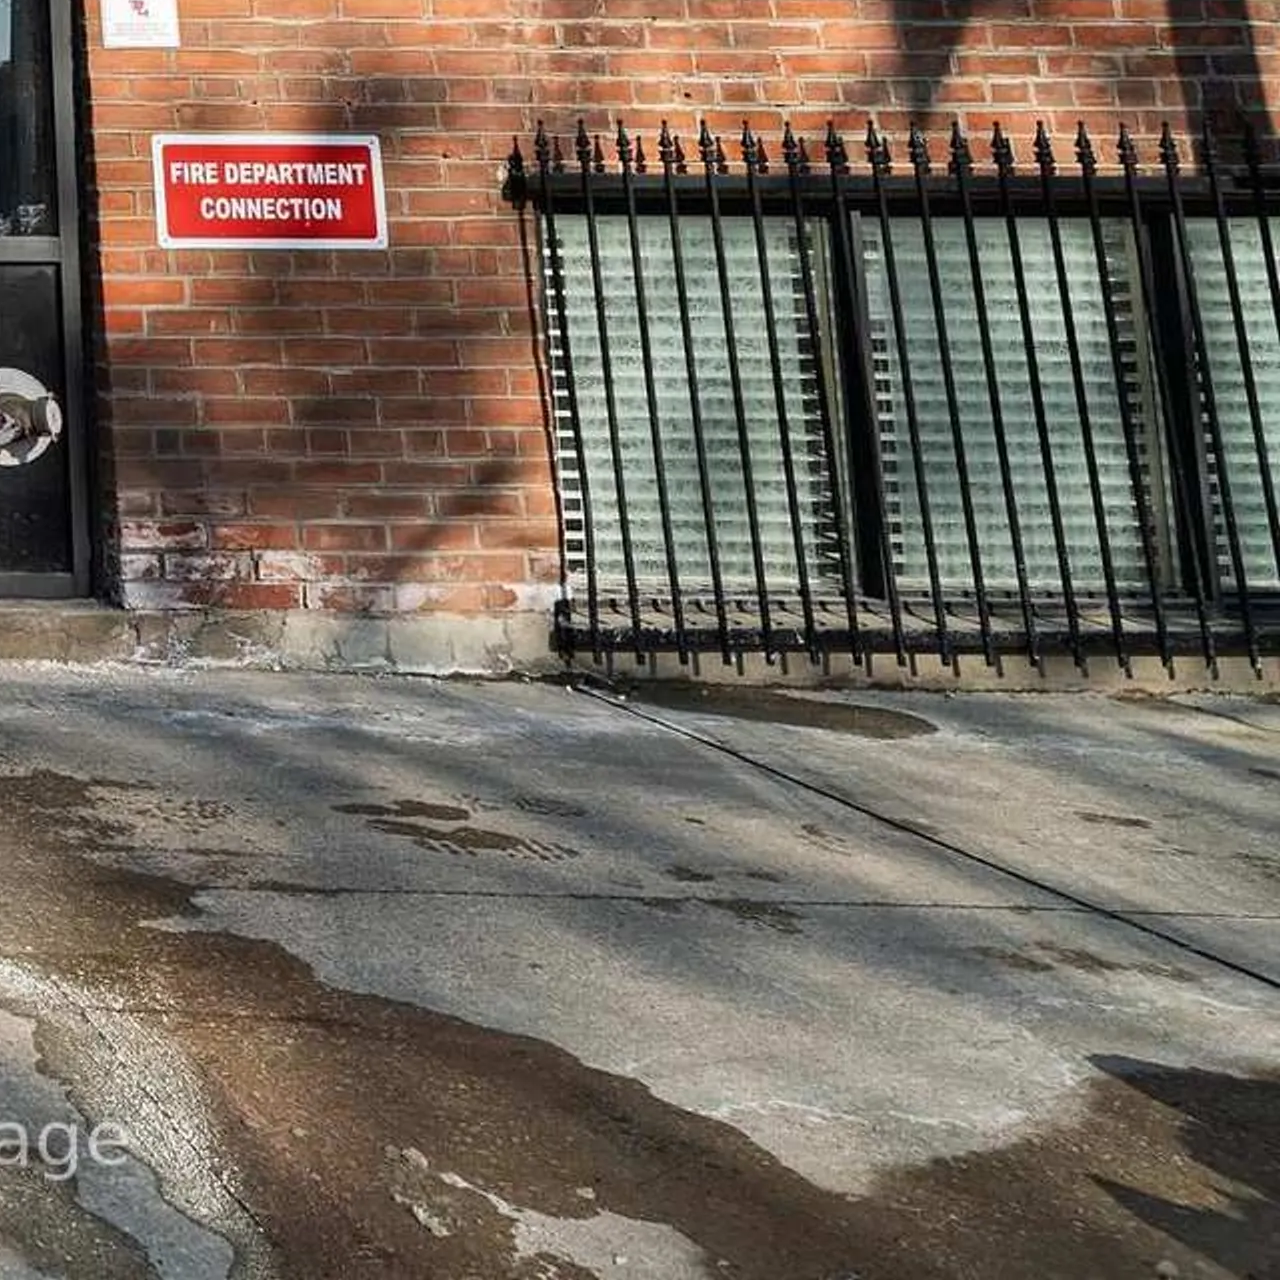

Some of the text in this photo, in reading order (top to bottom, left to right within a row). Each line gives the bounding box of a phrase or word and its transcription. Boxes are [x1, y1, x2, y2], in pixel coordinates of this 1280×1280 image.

[170, 162, 367, 186] FIRE DEPARTMENT
[200, 197, 342, 221] CONNECTION
